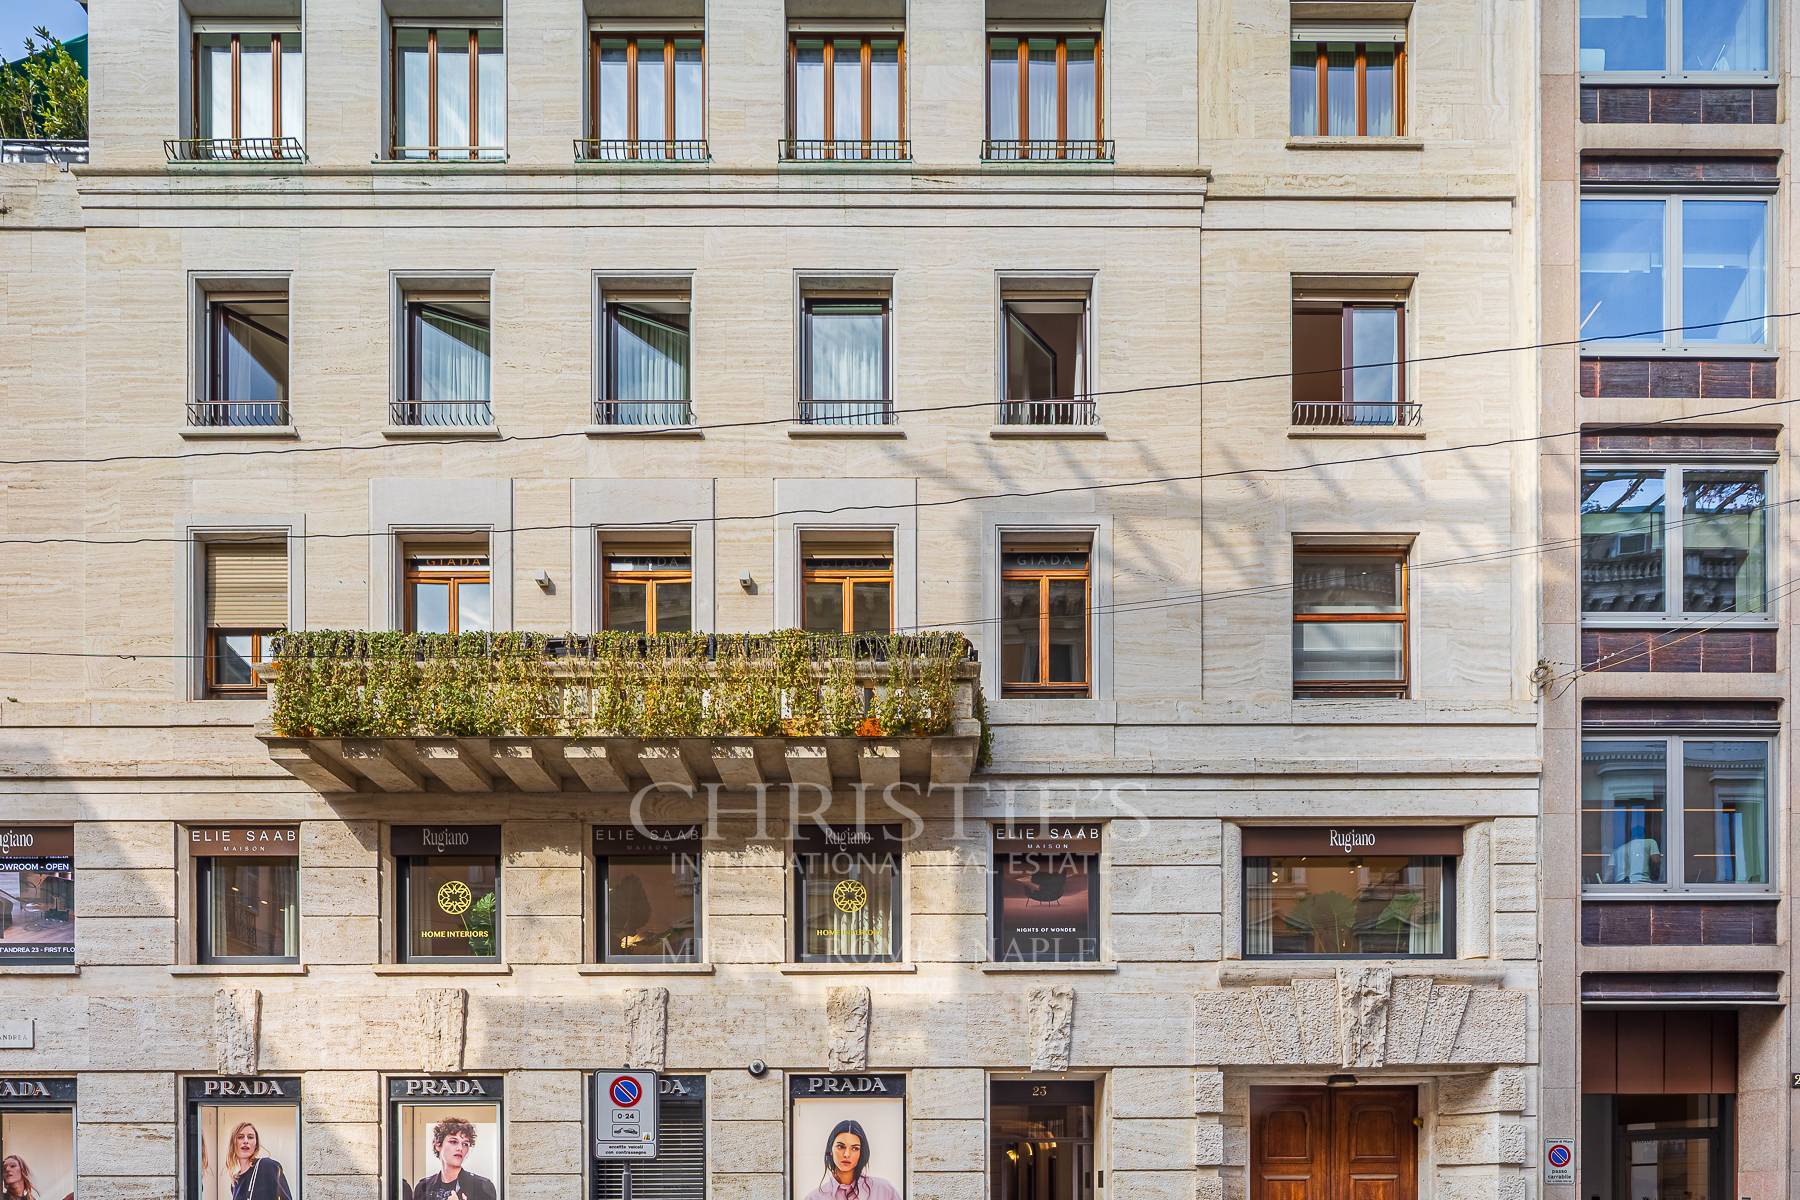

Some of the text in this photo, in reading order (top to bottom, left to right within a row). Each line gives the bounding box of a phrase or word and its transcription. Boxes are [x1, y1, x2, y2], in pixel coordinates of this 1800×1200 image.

[1016, 554, 1072, 566] GIADA
[192, 830, 296, 842] ELIE SAAB
[596, 829, 699, 841] ELIE SAAB
[825, 827, 871, 852] Rugiano
[996, 828, 1099, 840] ELIE SAAB
[423, 828, 469, 853] Rugiano
[1329, 829, 1376, 853] Rugiano
[45, 863, 70, 871] OPEN
[421, 930, 489, 938] HOME INTERIORS
[31, 946, 40, 954] 23
[44, 946, 61, 954] FIRST
[204, 1080, 284, 1095] PRADA
[406, 1079, 486, 1095] PRADA
[808, 1077, 887, 1092] PRADA
[1032, 1086, 1048, 1096] 23
